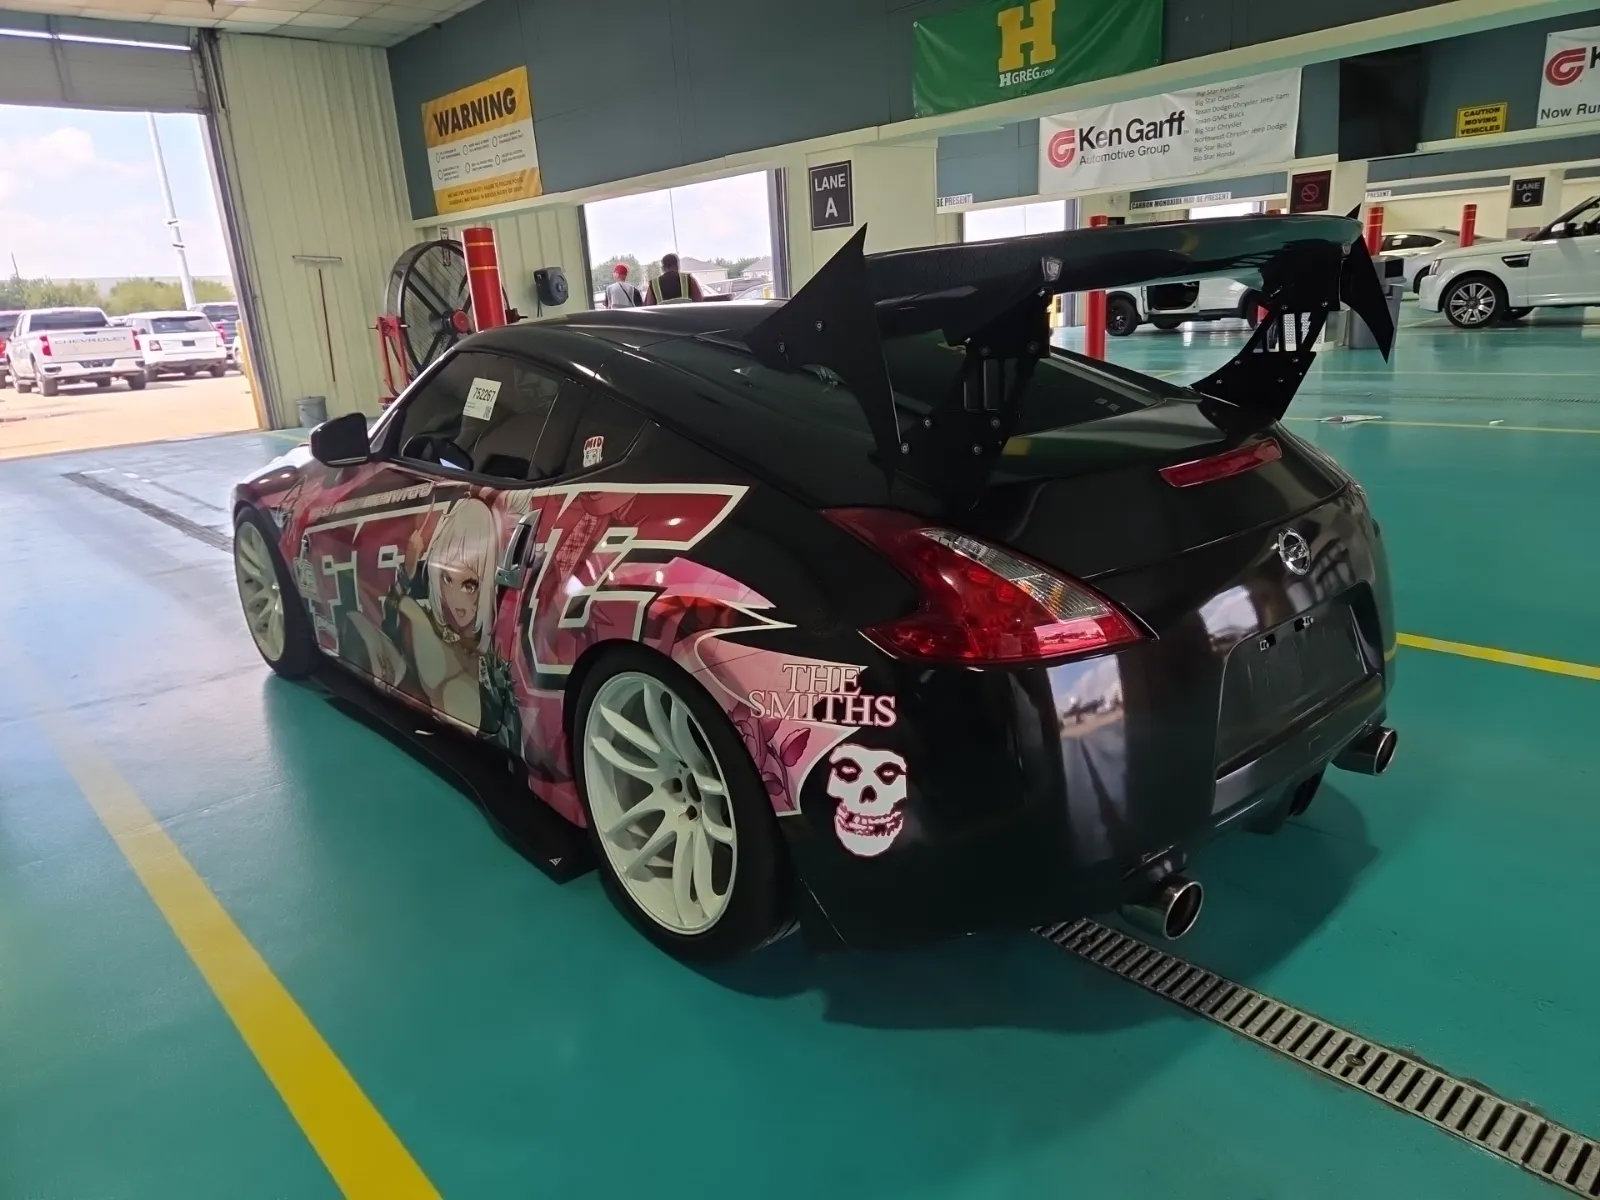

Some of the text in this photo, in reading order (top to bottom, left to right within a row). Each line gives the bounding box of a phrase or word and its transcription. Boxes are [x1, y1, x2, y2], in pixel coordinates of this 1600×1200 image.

[997, 0, 1056, 72] H
[433, 87, 517, 137] WARNING
[1212, 104, 1231, 113] Dodge
[1463, 107, 1501, 118] CAUTION
[1540, 107, 1572, 120] Now
[1212, 113, 1227, 122] GMC
[1228, 111, 1244, 119] Buick
[1465, 116, 1497, 126] MOVING
[1078, 110, 1185, 152] Ken Garff
[1266, 122, 1288, 131] Dodge
[1461, 125, 1501, 135] VEHICLES
[1079, 143, 1170, 166] Automotive Group
[814, 173, 846, 192] LANE
[1515, 181, 1541, 192] LANE
[1205, 192, 1230, 202] PRESENT
[1366, 190, 1390, 198] PRESENT
[1522, 193, 1532, 203] C
[945, 195, 971, 206] PRESENT
[825, 196, 838, 219] A
[54, 335, 128, 345] CHEVROLET
[473, 387, 496, 402] 752267
[782, 663, 863, 697] THE
[748, 690, 898, 728] SMITHS
